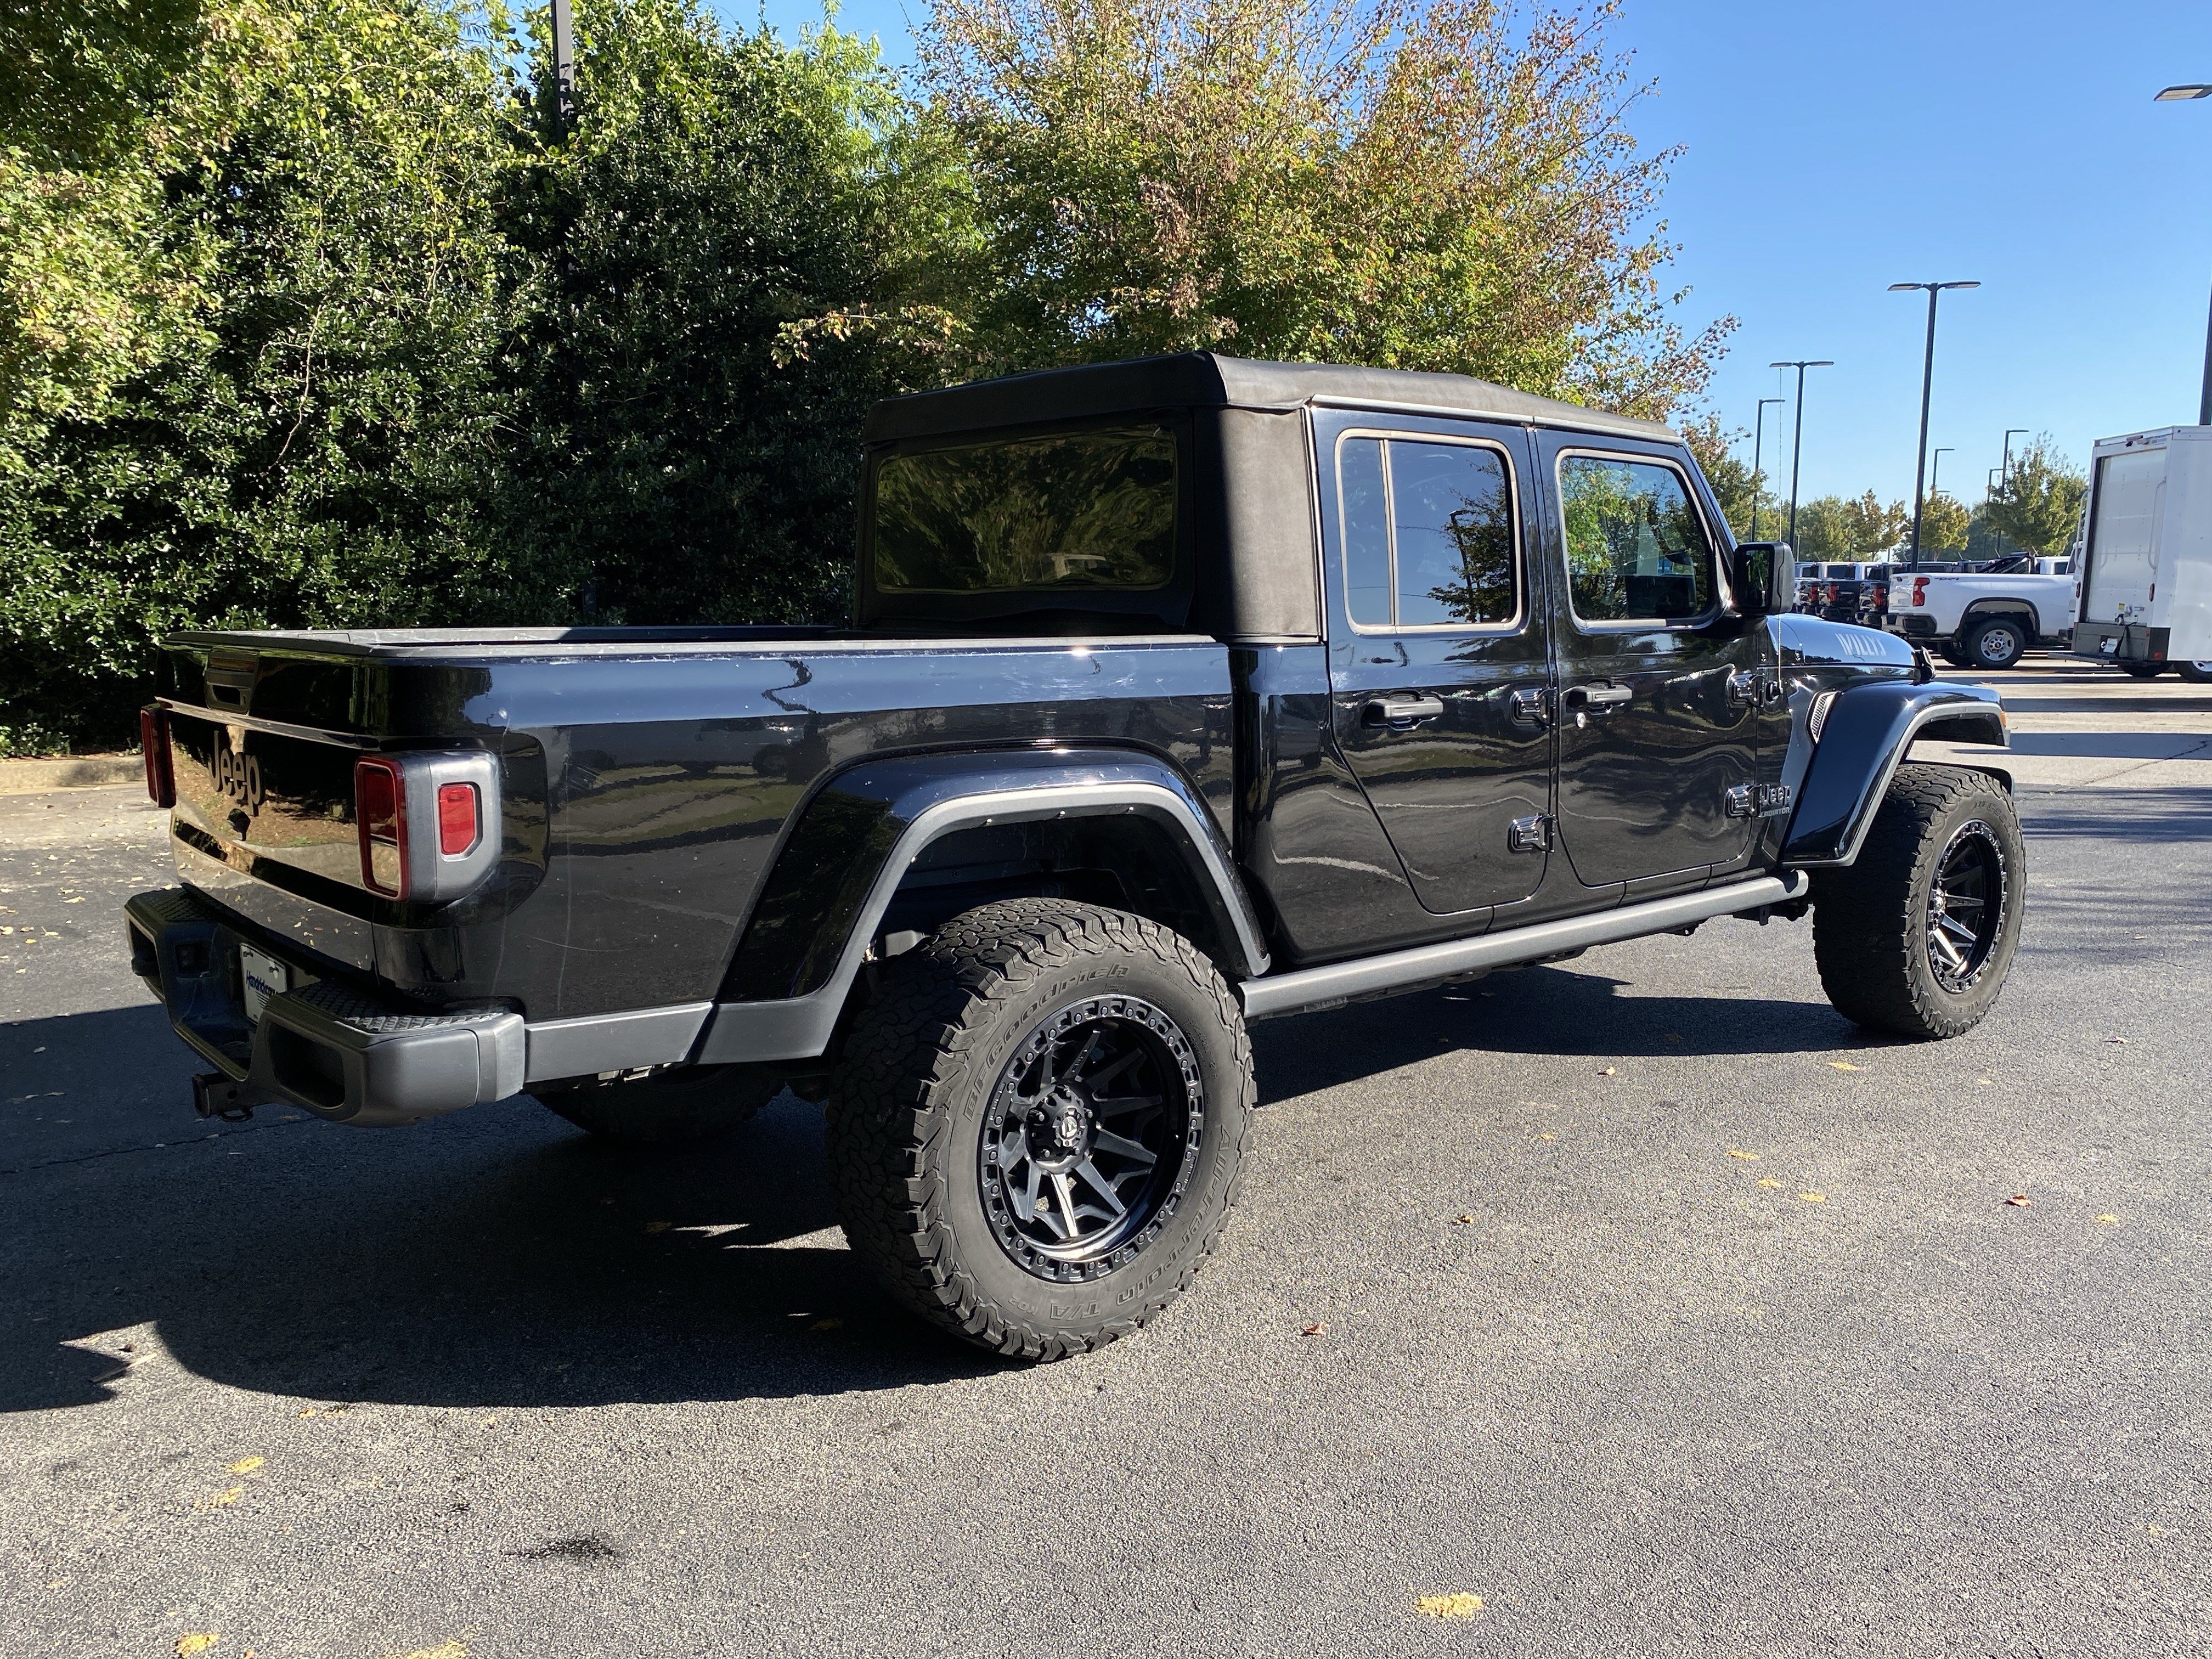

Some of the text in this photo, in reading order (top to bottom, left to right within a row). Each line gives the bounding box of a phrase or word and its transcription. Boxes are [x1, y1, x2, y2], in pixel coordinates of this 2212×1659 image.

[1835, 633, 1887, 657] WILLYS
[207, 730, 261, 816] Jeep
[1761, 784, 1792, 806] Jeep
[1757, 806, 1790, 818] LADIATOR
[963, 961, 1129, 1122] BFGoodrich
[1116, 1123, 1231, 1306] All-Terrain
[1049, 1300, 1102, 1321] T/A
